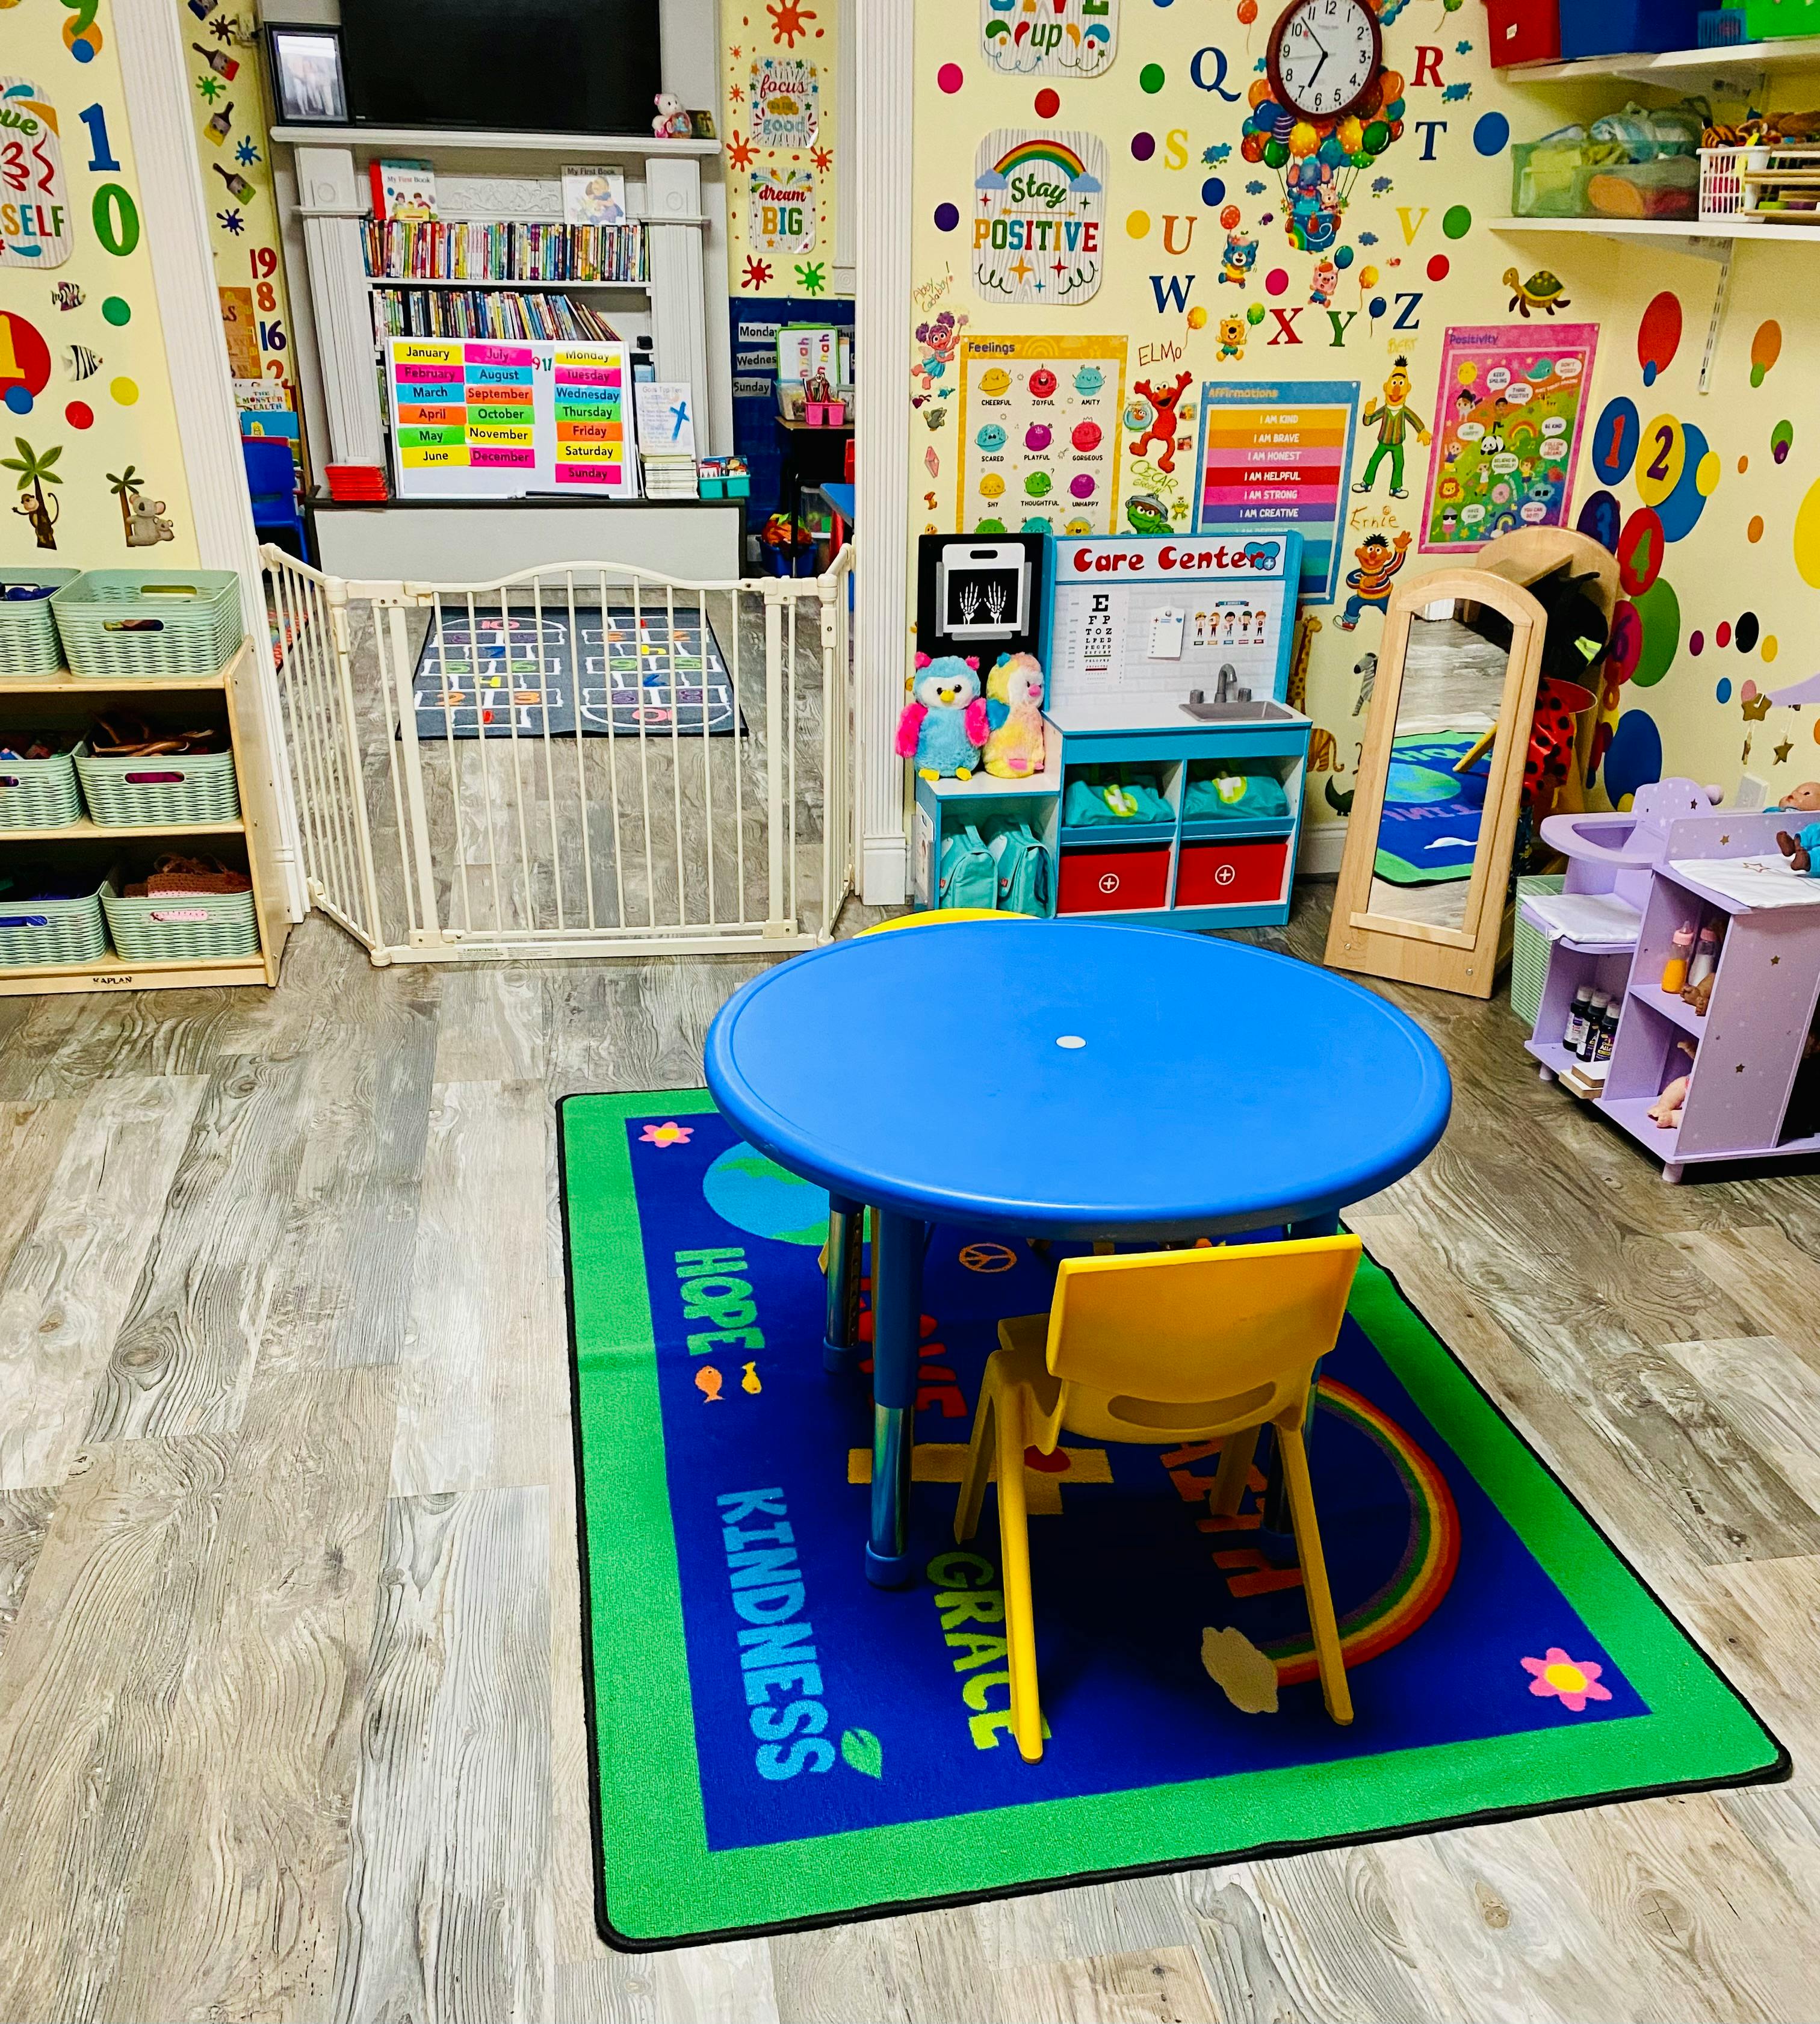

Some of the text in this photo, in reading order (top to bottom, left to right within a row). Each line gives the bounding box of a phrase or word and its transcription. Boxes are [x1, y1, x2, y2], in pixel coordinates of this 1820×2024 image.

[1308, 6, 1316, 20] 11
[1325, 1, 1337, 15] 12
[1347, 8, 1351, 23] 1
[1292, 23, 1302, 37] 10
[1357, 26, 1364, 40] 2
[1030, 23, 1062, 55] up
[1283, 44, 1290, 58] 9
[1359, 50, 1366, 63] 3
[1410, 46, 1444, 87] R
[1190, 46, 1242, 102] Q
[1286, 68, 1293, 81] 8
[1349, 73, 1357, 86] 4
[760, 74, 805, 99] focus
[1298, 85, 1305, 98] 7
[1314, 93, 1322, 106] 6
[1334, 88, 1341, 102] 5
[763, 116, 805, 135] good
[1415, 122, 1447, 160] T
[1164, 129, 1189, 170] S
[759, 185, 806, 202] dream
[1011, 173, 1066, 208] Stay
[0, 203, 64, 237] SELF
[762, 206, 802, 235] BIG
[1396, 207, 1429, 246] V
[974, 219, 1098, 252] POSITIVE
[1162, 215, 1198, 255] U
[250, 247, 277, 279] 19
[256, 282, 276, 312] 8
[914, 277, 933, 304] Abby
[1149, 274, 1195, 314] W
[1393, 292, 1423, 330] Z
[1267, 308, 1304, 345] X
[1326, 311, 1358, 347] Y
[259, 320, 286, 351] 16
[1449, 334, 1498, 345] Positivity
[406, 347, 450, 361] January
[487, 348, 509, 361] July
[968, 342, 1015, 355] Feelings
[566, 351, 609, 362] Monday
[405, 367, 455, 381] February
[480, 370, 519, 382] August
[568, 369, 610, 381] Tuesday
[413, 386, 448, 397] March
[468, 388, 529, 401] September
[557, 387, 620, 401] Wednesday
[734, 382, 769, 394] Sunday
[419, 409, 445, 421] April
[478, 408, 524, 419] October
[563, 406, 613, 419] Thursday
[1260, 415, 1298, 424] I AM KIND
[419, 431, 443, 442] May
[470, 427, 528, 440] November
[573, 426, 607, 438] Friday
[1254, 433, 1299, 443] I AM BRAVE
[1605, 414, 1625, 468] 1
[423, 451, 448, 461] June
[473, 451, 529, 462] December
[566, 446, 613, 458] Saturday
[1248, 451, 1301, 460] I AM HONEST
[1646, 425, 1674, 481] 2
[568, 468, 607, 480] Sunday
[1130, 460, 1178, 494] OSCAR
[1244, 471, 1301, 481] I AM HELPFUL
[1244, 490, 1298, 500] I AM STRONG
[1239, 509, 1299, 518] I AM CREATIVE
[1350, 506, 1399, 531] Ernie
[1074, 545, 1264, 572] Care Center
[1629, 528, 1651, 583] 4
[1092, 595, 1109, 611] E
[93, 976, 132, 985] KAPLAN
[675, 1248, 767, 1355] HOPE
[716, 1487, 835, 1781] KINDNESS
[926, 1552, 1053, 1750] GRACE
